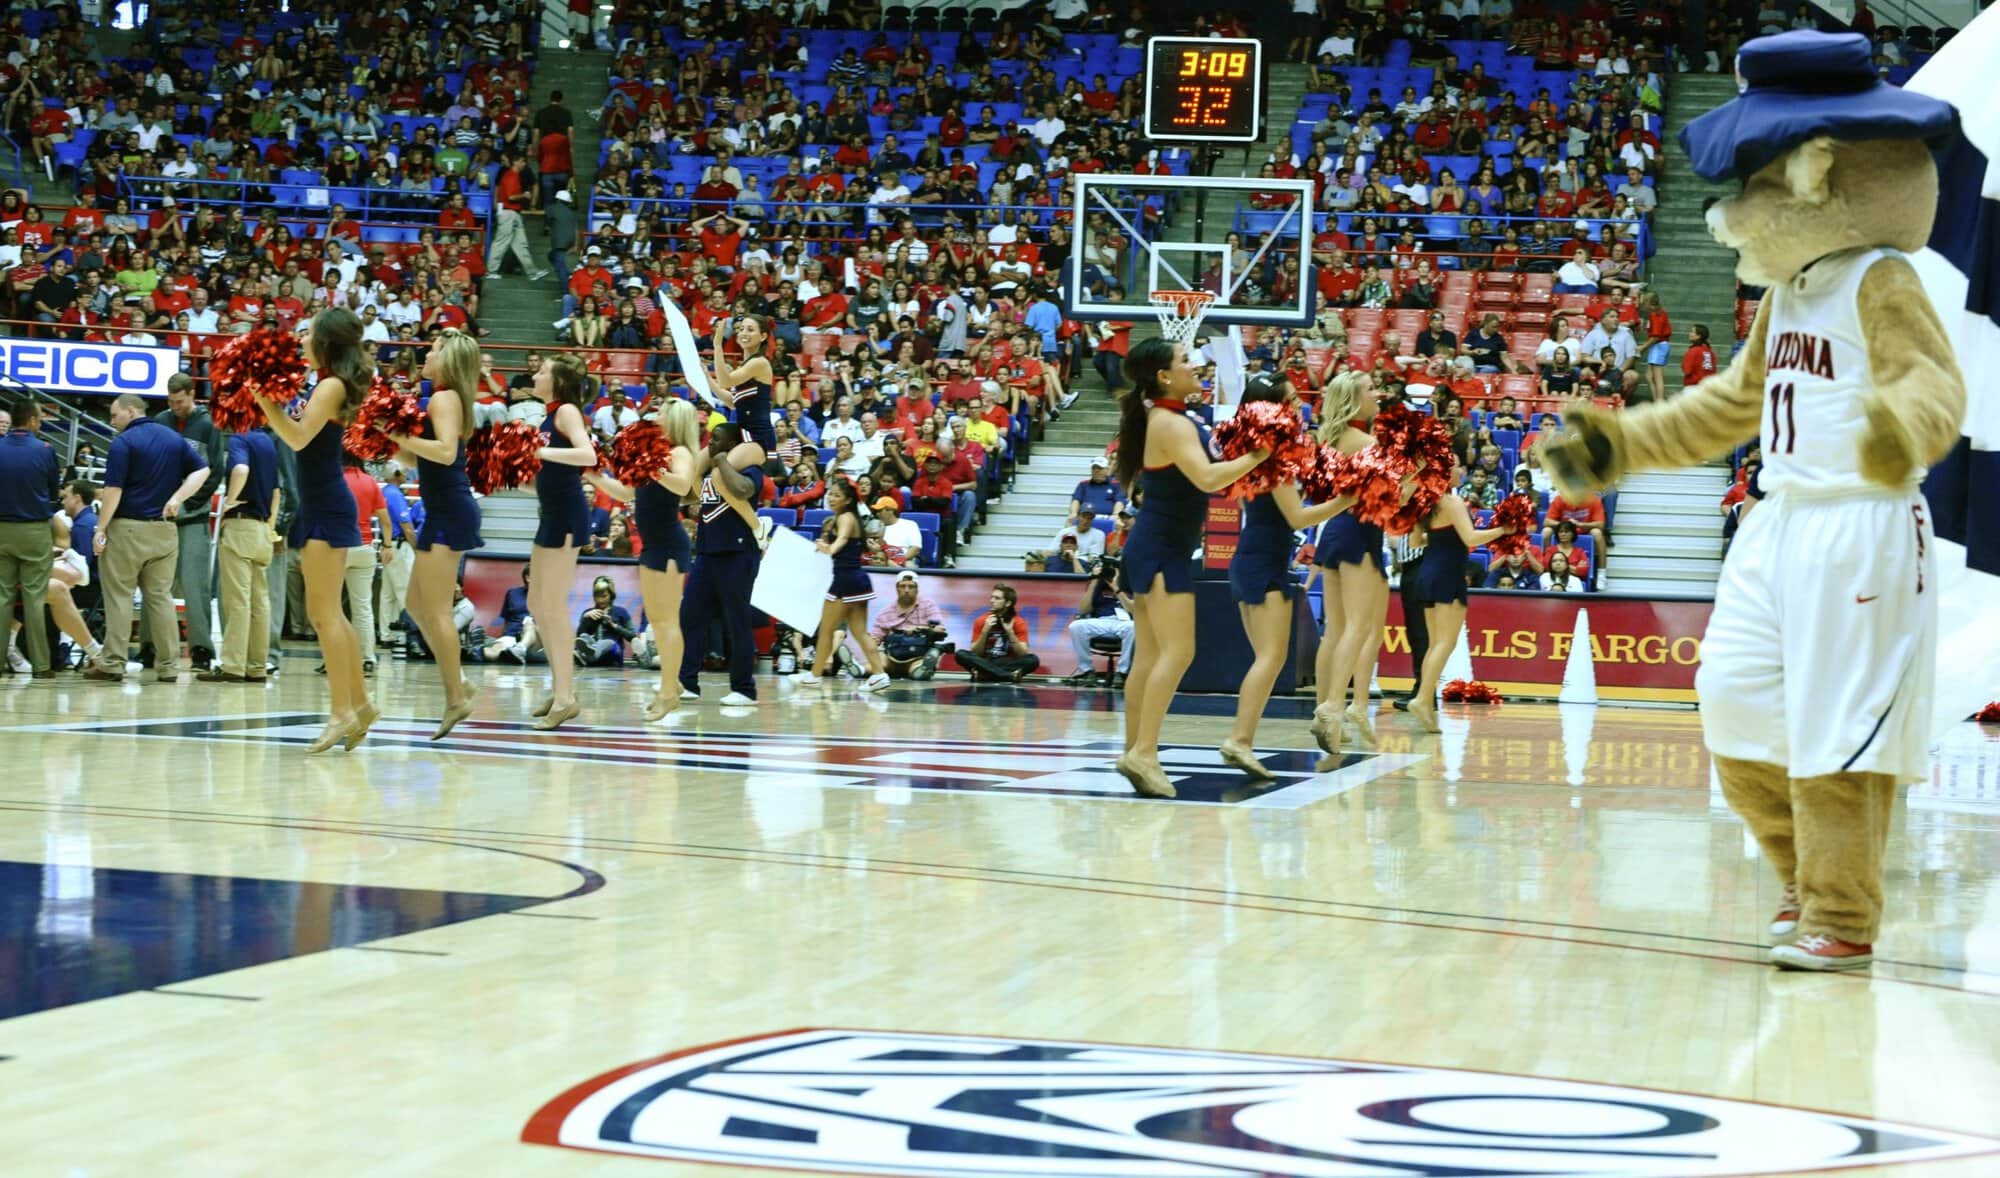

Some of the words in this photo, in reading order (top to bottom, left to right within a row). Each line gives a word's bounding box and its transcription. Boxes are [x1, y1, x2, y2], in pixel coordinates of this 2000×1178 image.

[1180, 52, 1247, 77] 3:09
[1173, 87, 1232, 124] 32
[0, 344, 157, 389] EICO
[1770, 382, 1796, 454] 11
[700, 476, 720, 504] A
[1383, 625, 1538, 660] WLS
